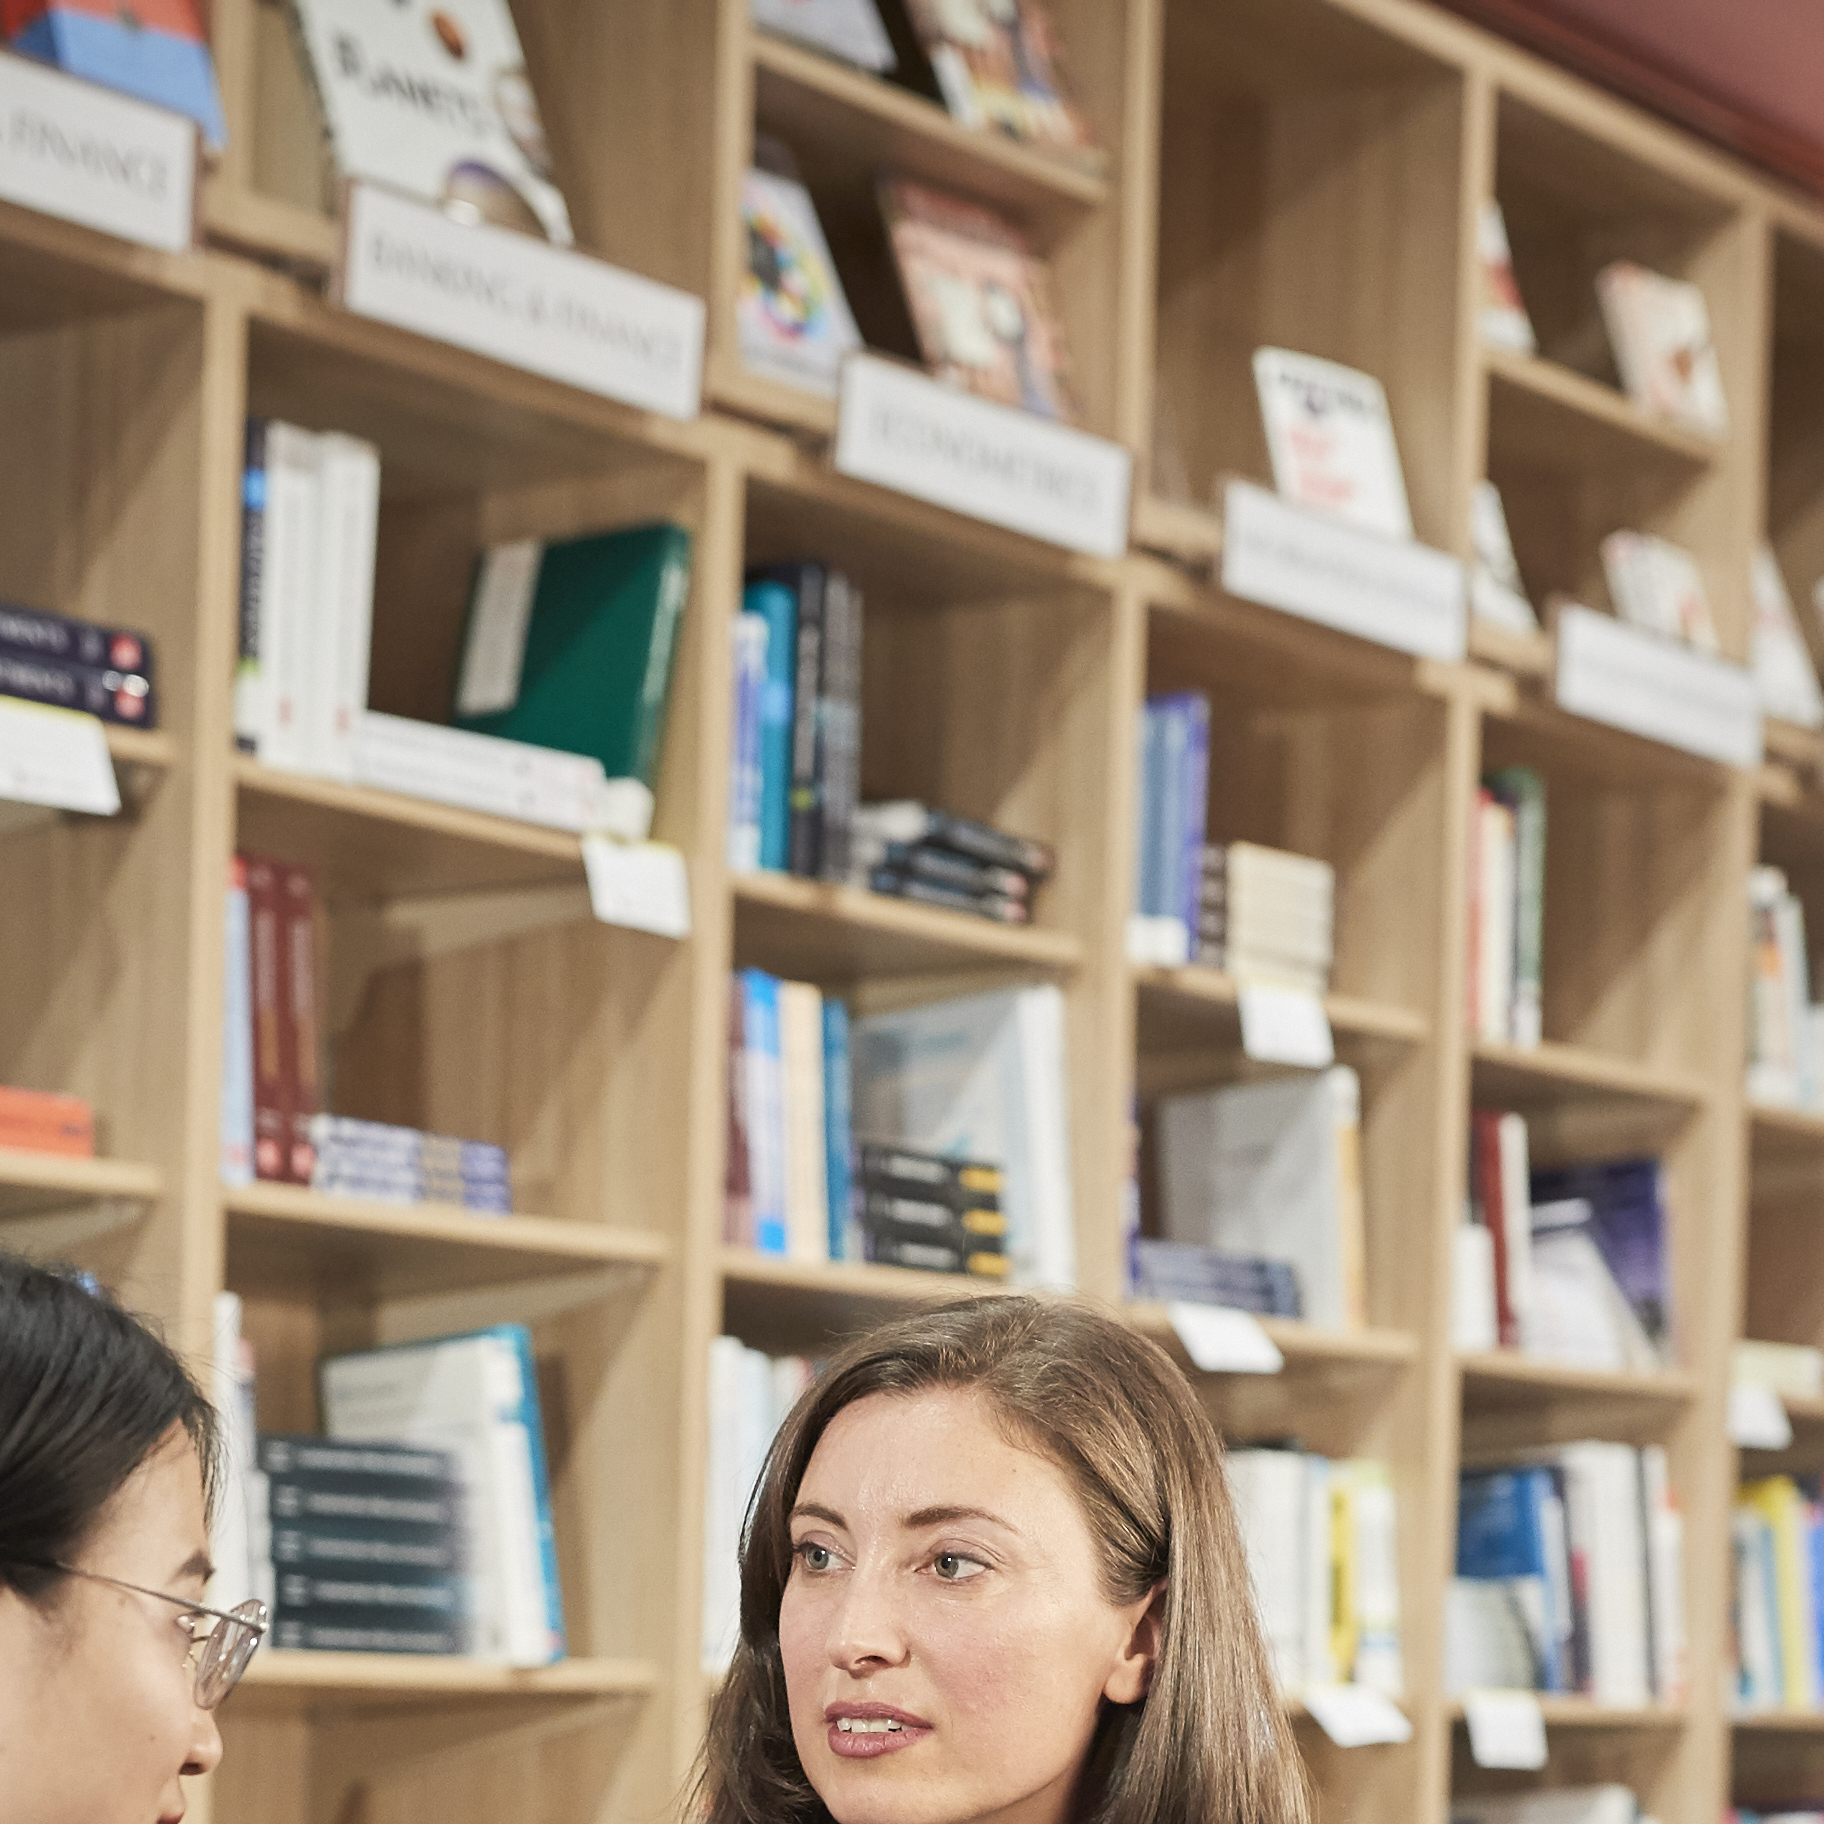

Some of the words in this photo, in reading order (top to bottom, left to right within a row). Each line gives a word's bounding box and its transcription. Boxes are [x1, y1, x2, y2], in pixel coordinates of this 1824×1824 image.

[11, 108, 169, 198] FINANCE
[373, 237, 507, 312] BANKING
[557, 294, 681, 372] FINANCE
